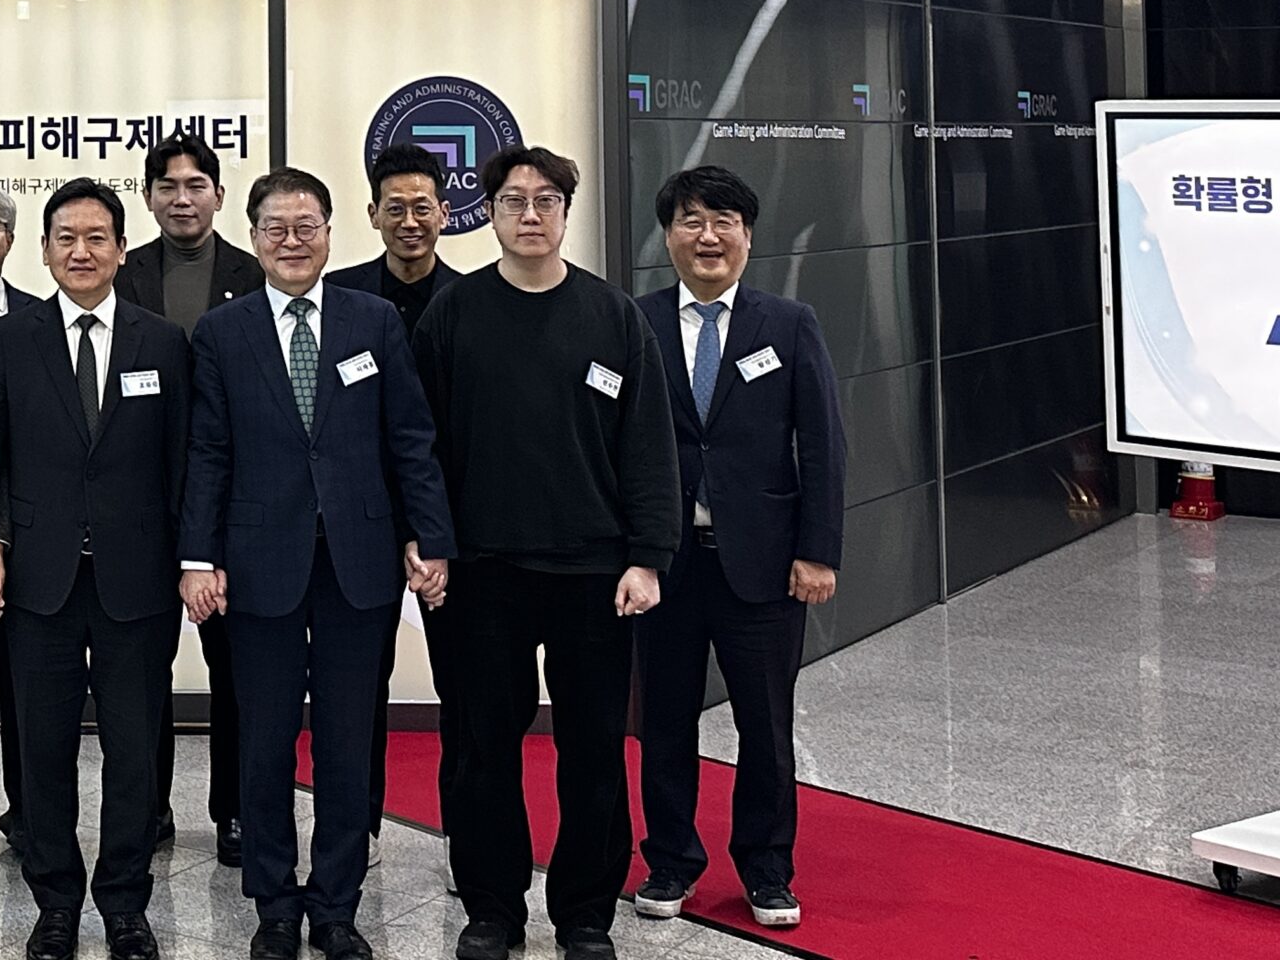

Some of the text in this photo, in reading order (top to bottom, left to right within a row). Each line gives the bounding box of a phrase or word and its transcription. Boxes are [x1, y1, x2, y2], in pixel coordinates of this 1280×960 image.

[654, 79, 702, 109] GRAC
[1032, 94, 1057, 116] GRAC
[373, 83, 503, 151] RATING AND ADMINISTRATION
[713, 123, 845, 141] Game Rating and Administration Committee
[445, 172, 478, 189] AC
[1172, 174, 1273, 215] 확률형
